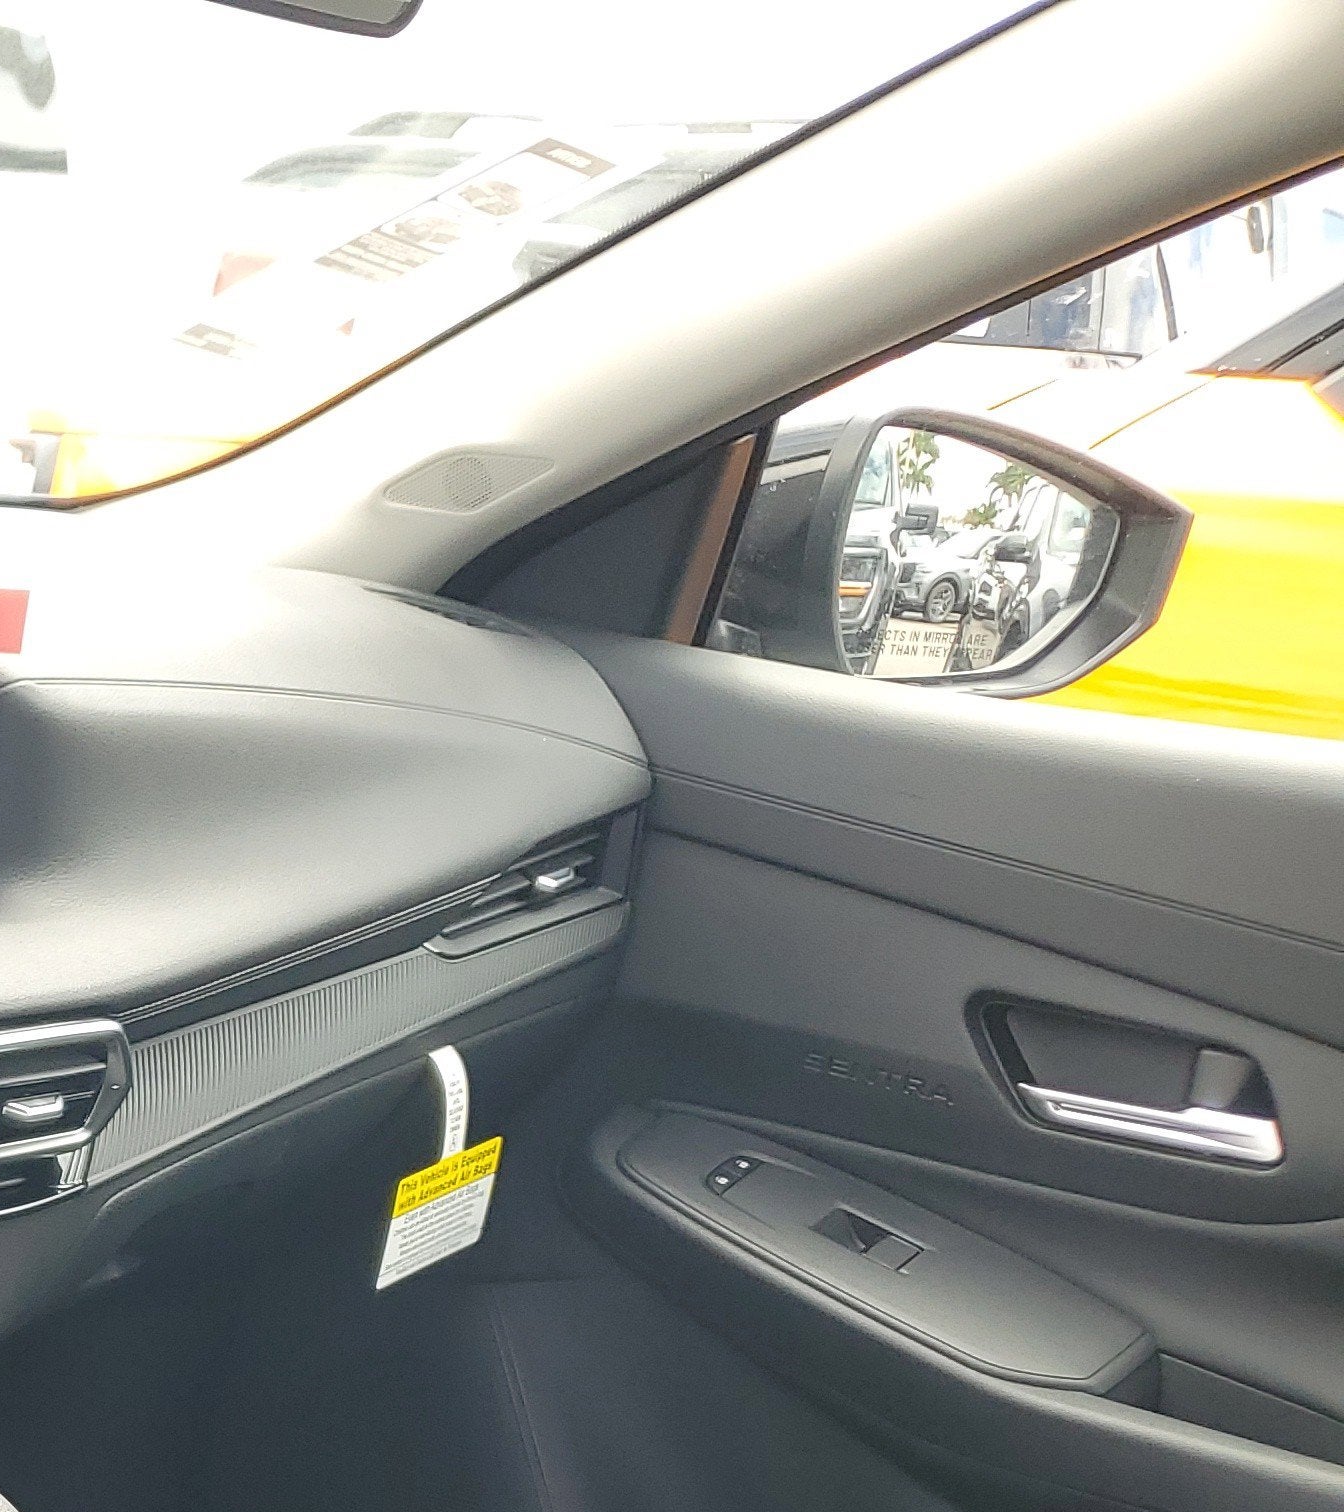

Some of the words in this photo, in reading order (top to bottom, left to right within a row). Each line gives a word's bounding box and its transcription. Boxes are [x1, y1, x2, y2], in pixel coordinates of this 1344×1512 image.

[923, 631, 961, 644] MIRRO
[966, 634, 989, 647] ARE
[890, 644, 919, 657] THAN
[922, 645, 950, 658] THEY
